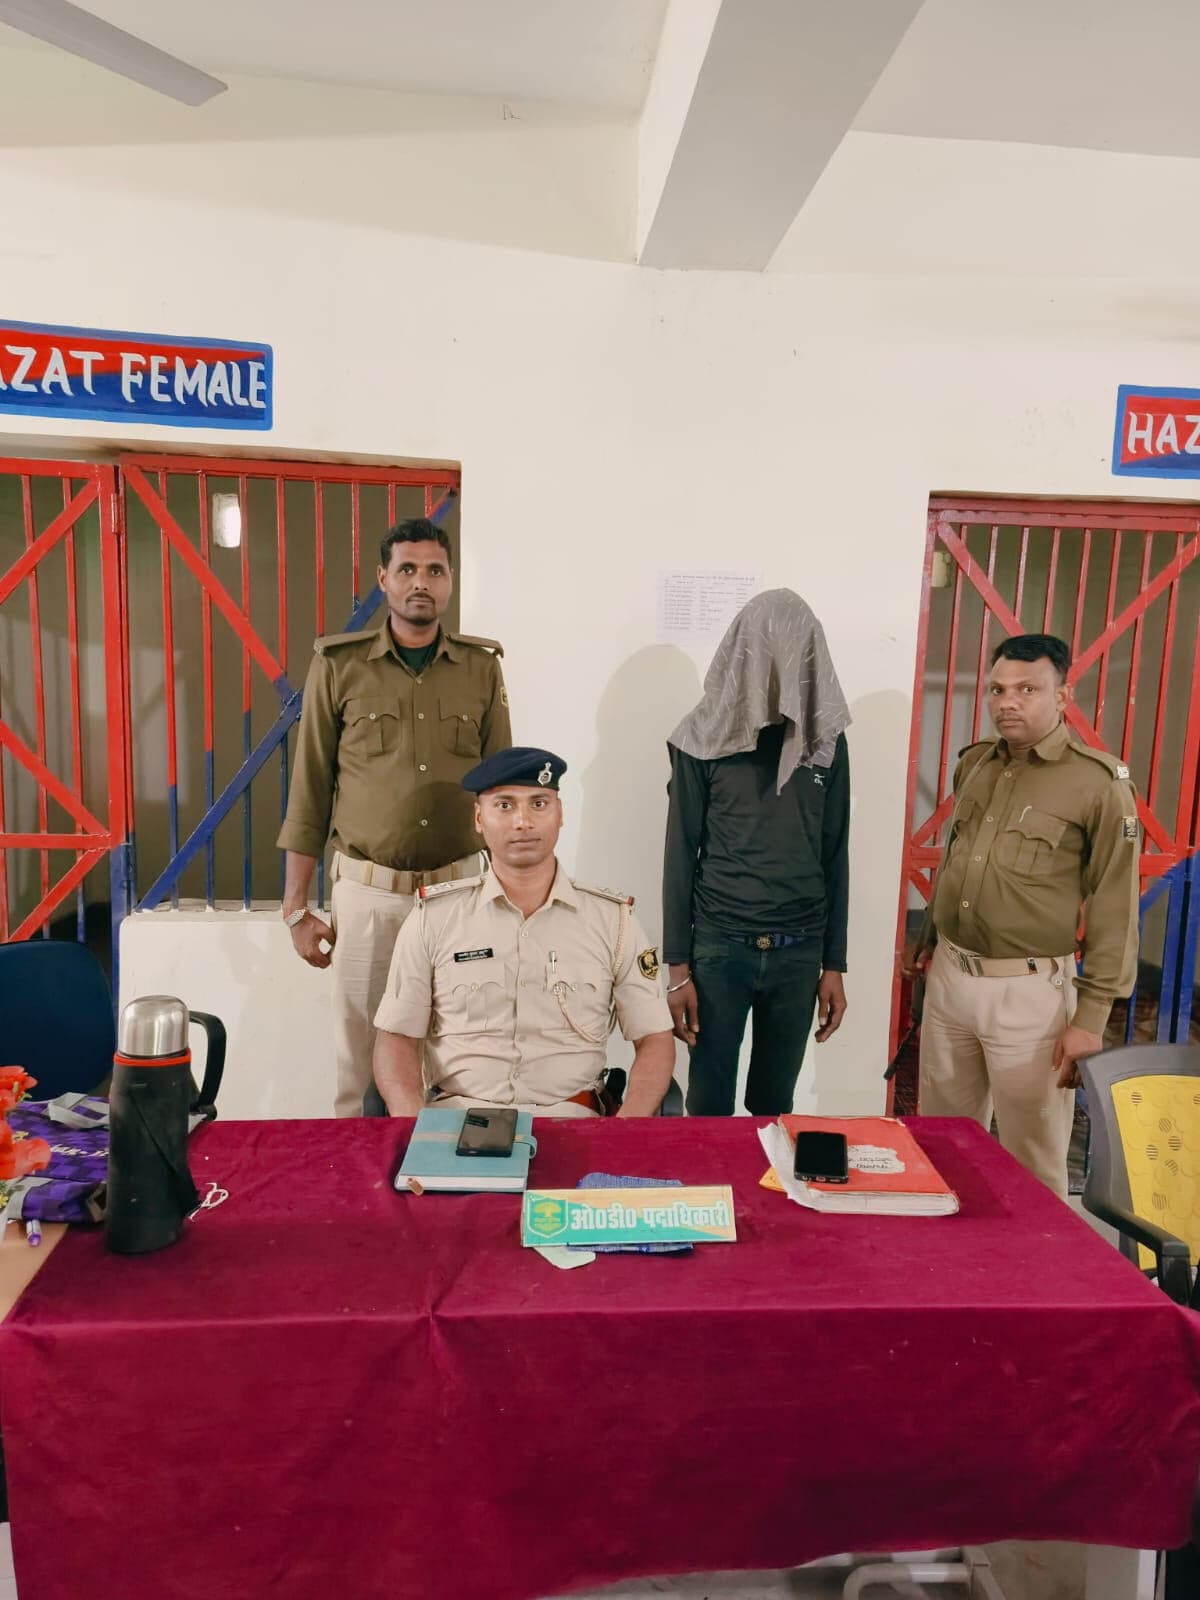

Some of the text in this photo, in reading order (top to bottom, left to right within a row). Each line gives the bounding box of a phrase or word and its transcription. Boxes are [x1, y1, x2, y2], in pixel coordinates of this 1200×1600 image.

[0, 345, 267, 409] ZAT FEMALE
[1127, 411, 1200, 455] HAZ
[641, 1200, 731, 1229] पदाधिकारी
